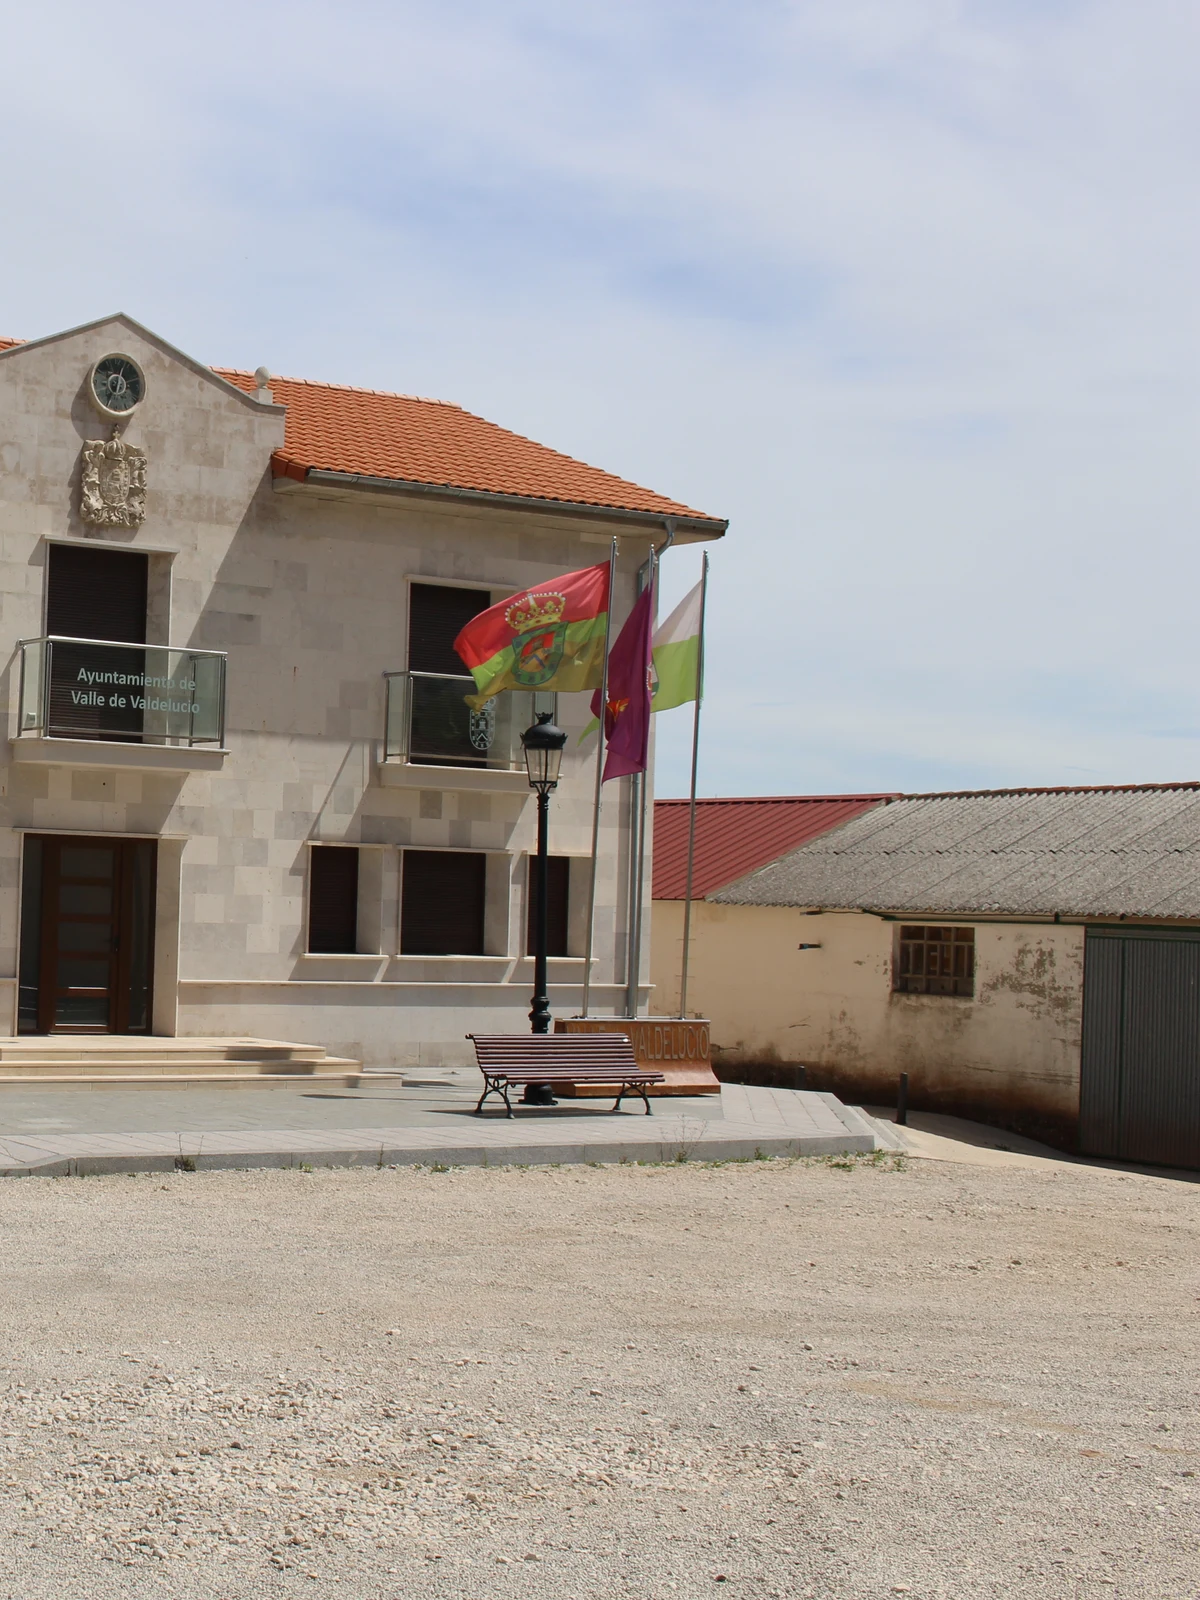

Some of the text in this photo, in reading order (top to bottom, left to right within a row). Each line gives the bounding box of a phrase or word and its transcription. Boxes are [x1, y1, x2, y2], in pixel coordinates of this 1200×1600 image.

[77, 667, 196, 691] Ayuntamiento de
[71, 690, 200, 714] Valle de Valdelucio
[629, 1026, 710, 1060] VALDELUCIO
